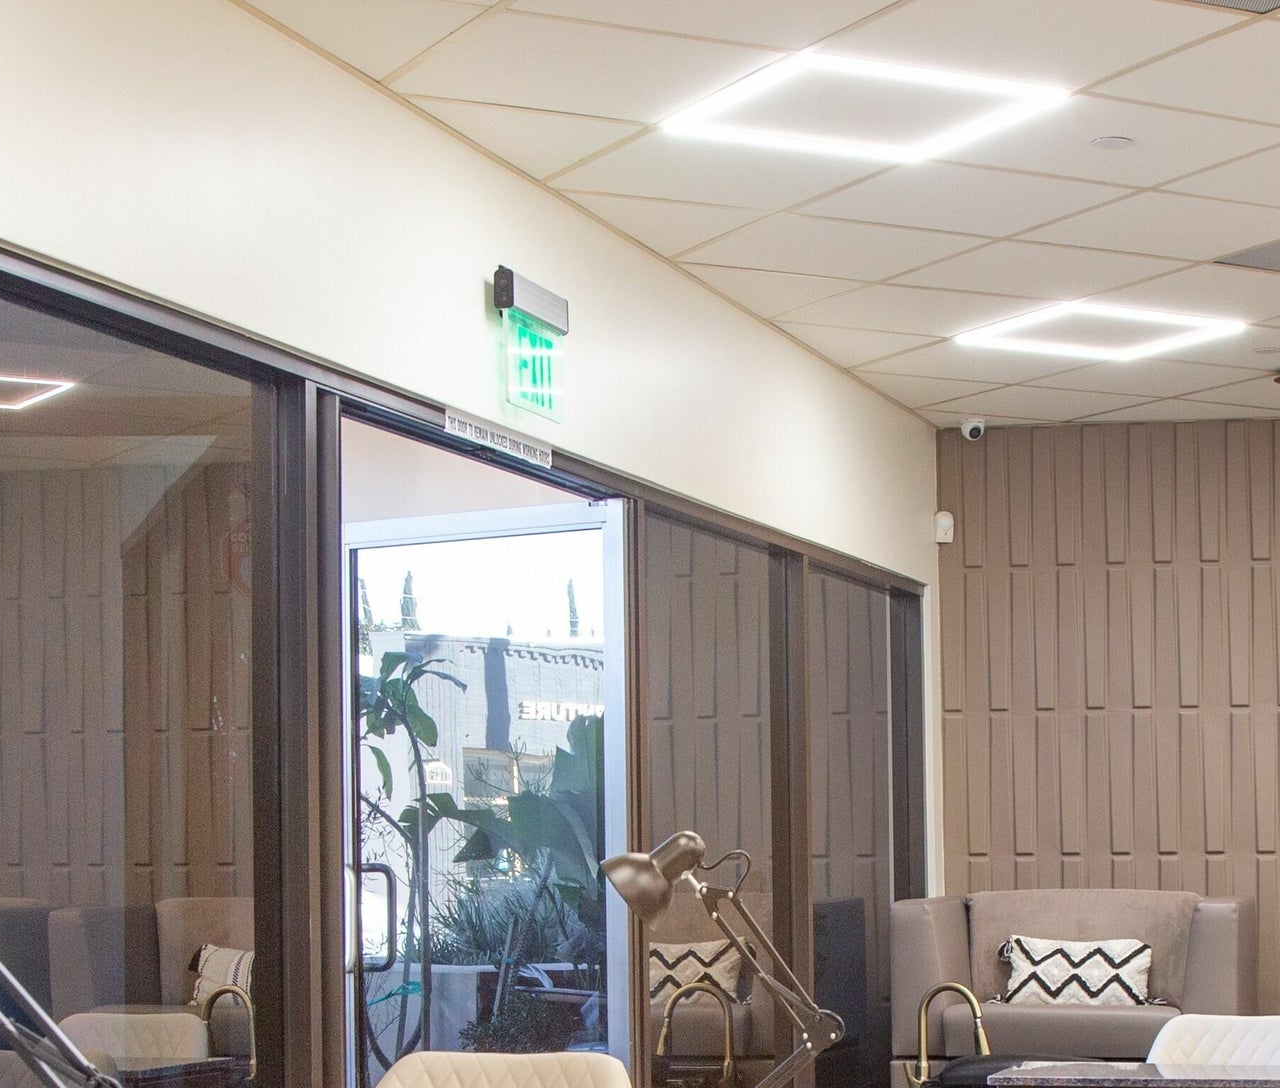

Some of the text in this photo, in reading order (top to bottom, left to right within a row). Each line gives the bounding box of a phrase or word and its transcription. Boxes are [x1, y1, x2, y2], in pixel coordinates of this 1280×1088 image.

[518, 325, 554, 410] EXIT
[447, 415, 457, 430] THIS
[457, 418, 468, 434] DOOR
[474, 425, 489, 442] REMAIN
[489, 430, 508, 449] UNLOCKED
[508, 437, 522, 455] DURING
[522, 442, 538, 460] WORKING
[538, 448, 550, 465] HOURS
